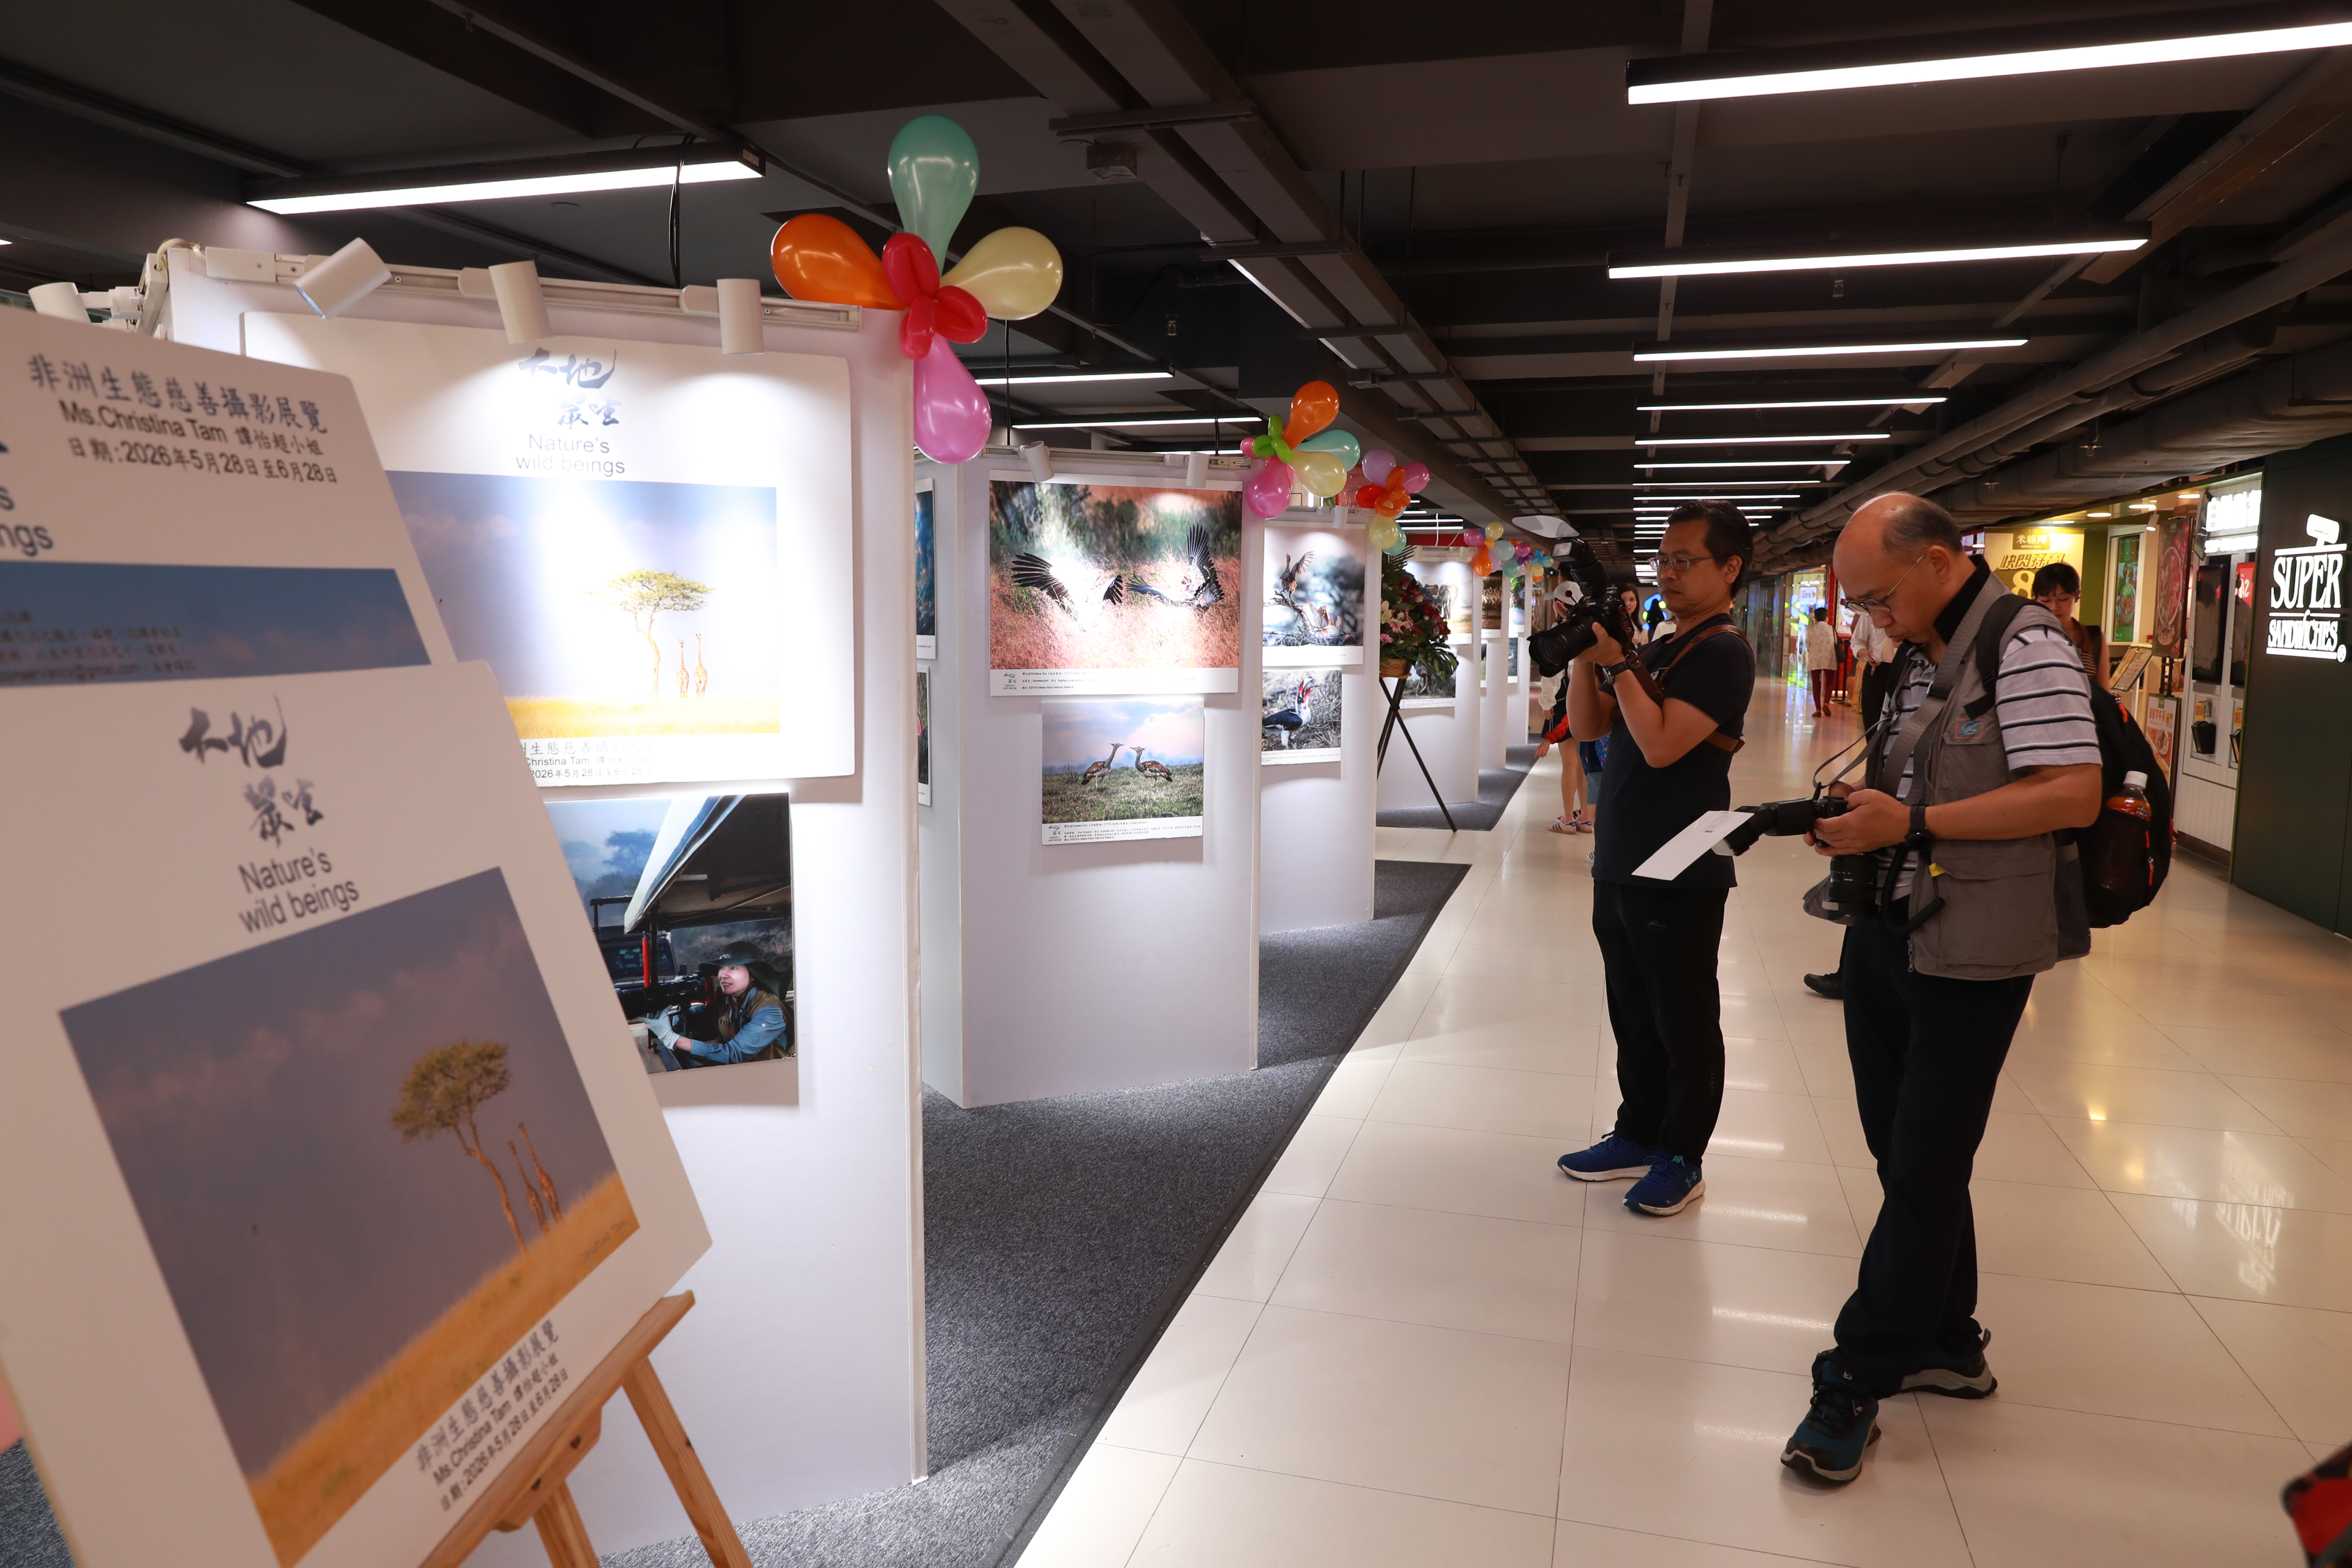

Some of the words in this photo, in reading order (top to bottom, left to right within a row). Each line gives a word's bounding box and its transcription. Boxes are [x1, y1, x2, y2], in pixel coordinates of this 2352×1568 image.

[27, 353, 327, 434] 非洲生態慈善攝影展覽
[58, 398, 186, 438] Ms.Christina
[186, 417, 228, 443] Tam
[529, 434, 609, 453] Nature's
[516, 454, 553, 470] wild
[562, 455, 625, 477] beings
[2271, 554, 2343, 609] SUPER
[2268, 609, 2338, 651] SANDWICHES
[570, 756, 590, 765] Tam
[238, 848, 332, 894] Nature's
[239, 897, 287, 934] wild
[291, 880, 360, 920] beings
[490, 1400, 512, 1424] Tam
